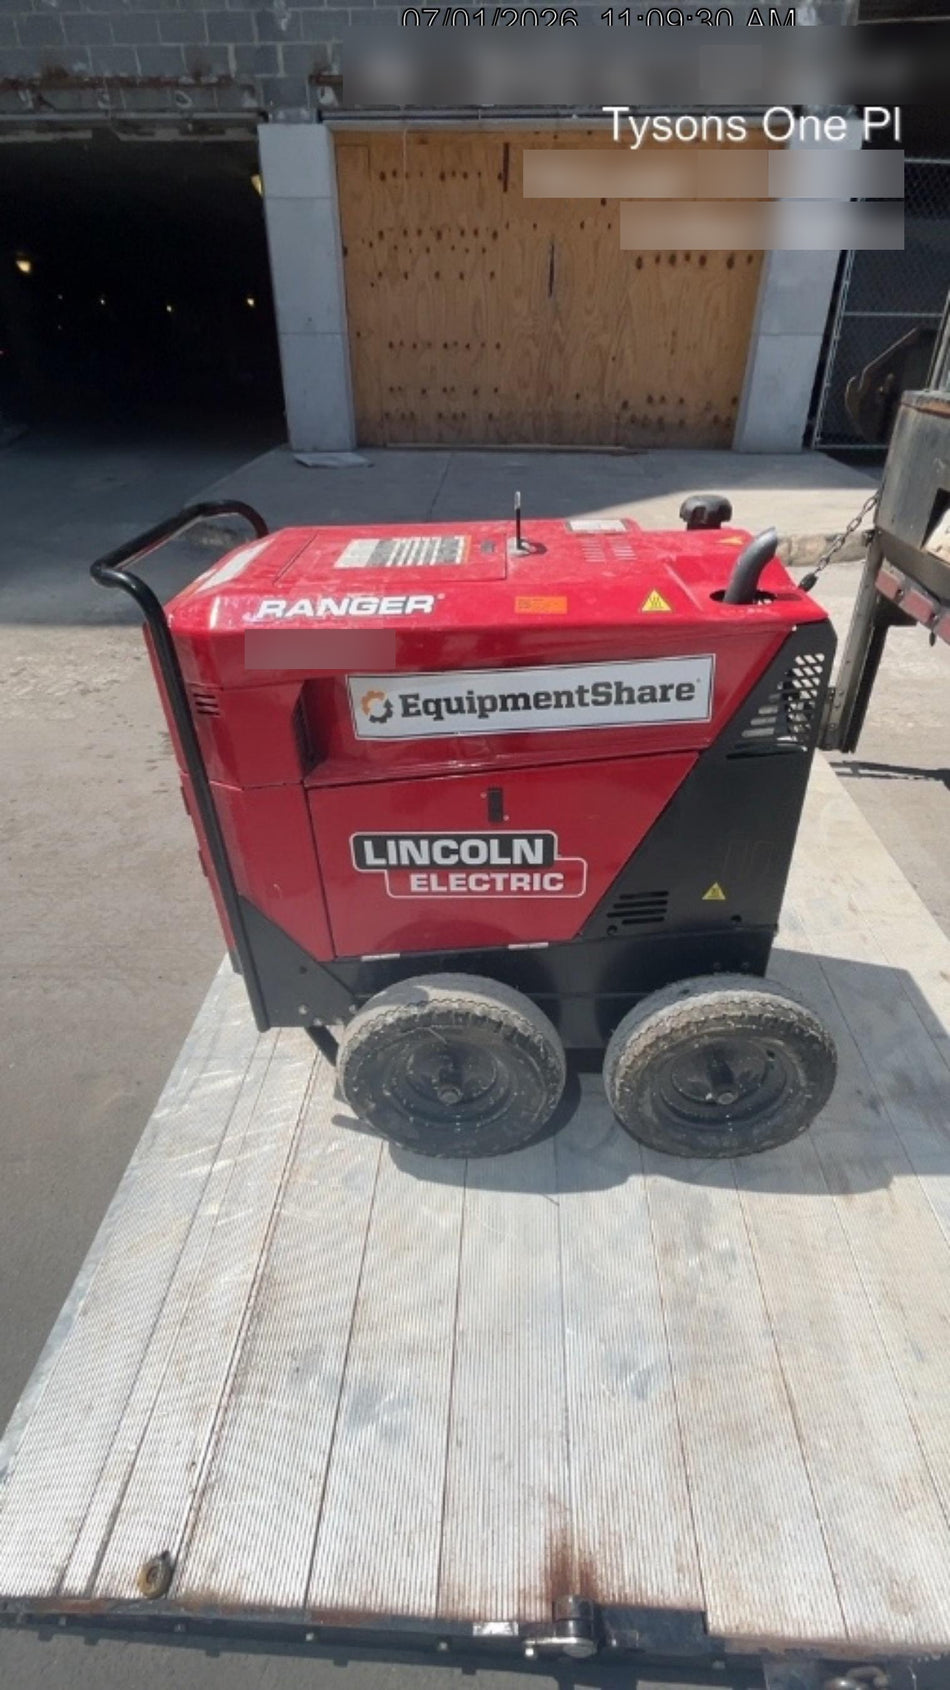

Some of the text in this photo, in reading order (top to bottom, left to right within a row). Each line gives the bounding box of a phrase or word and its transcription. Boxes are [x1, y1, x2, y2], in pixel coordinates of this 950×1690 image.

[252, 595, 435, 619] RANGER
[400, 681, 695, 721] EquipmentShare
[363, 838, 543, 866] LINCOLN
[410, 872, 565, 893] ELECTRIC
